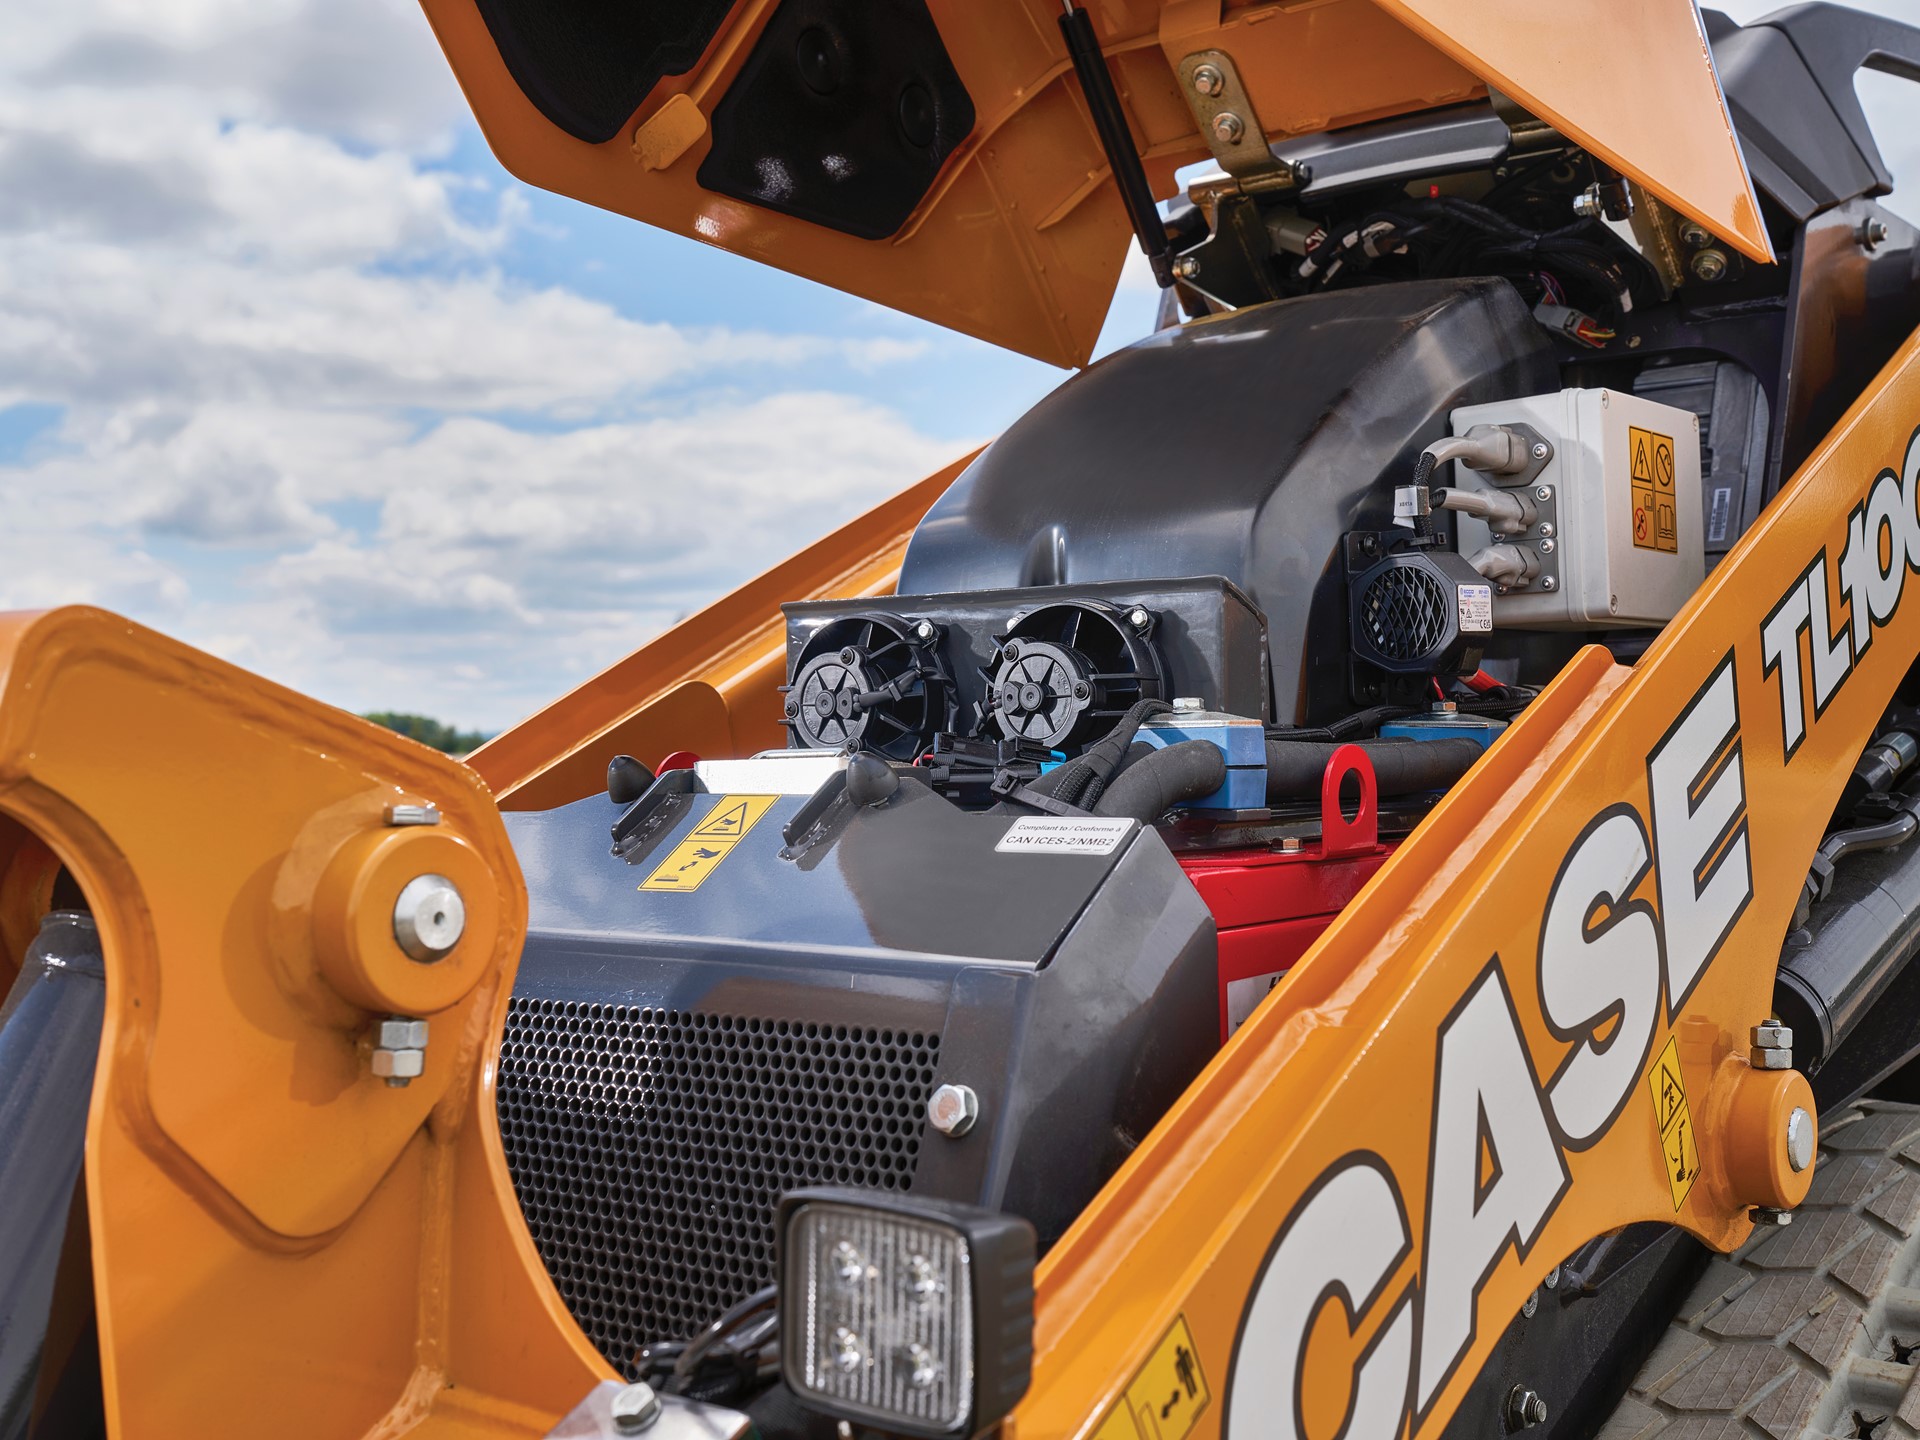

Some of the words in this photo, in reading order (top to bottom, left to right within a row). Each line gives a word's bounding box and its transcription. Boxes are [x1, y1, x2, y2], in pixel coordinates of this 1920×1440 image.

[1018, 824, 1057, 832] Compliant
[1006, 836, 1034, 844] CAN
[1034, 837, 1115, 846] ICES-2/NMB2
[1226, 648, 1753, 1440] CASE
